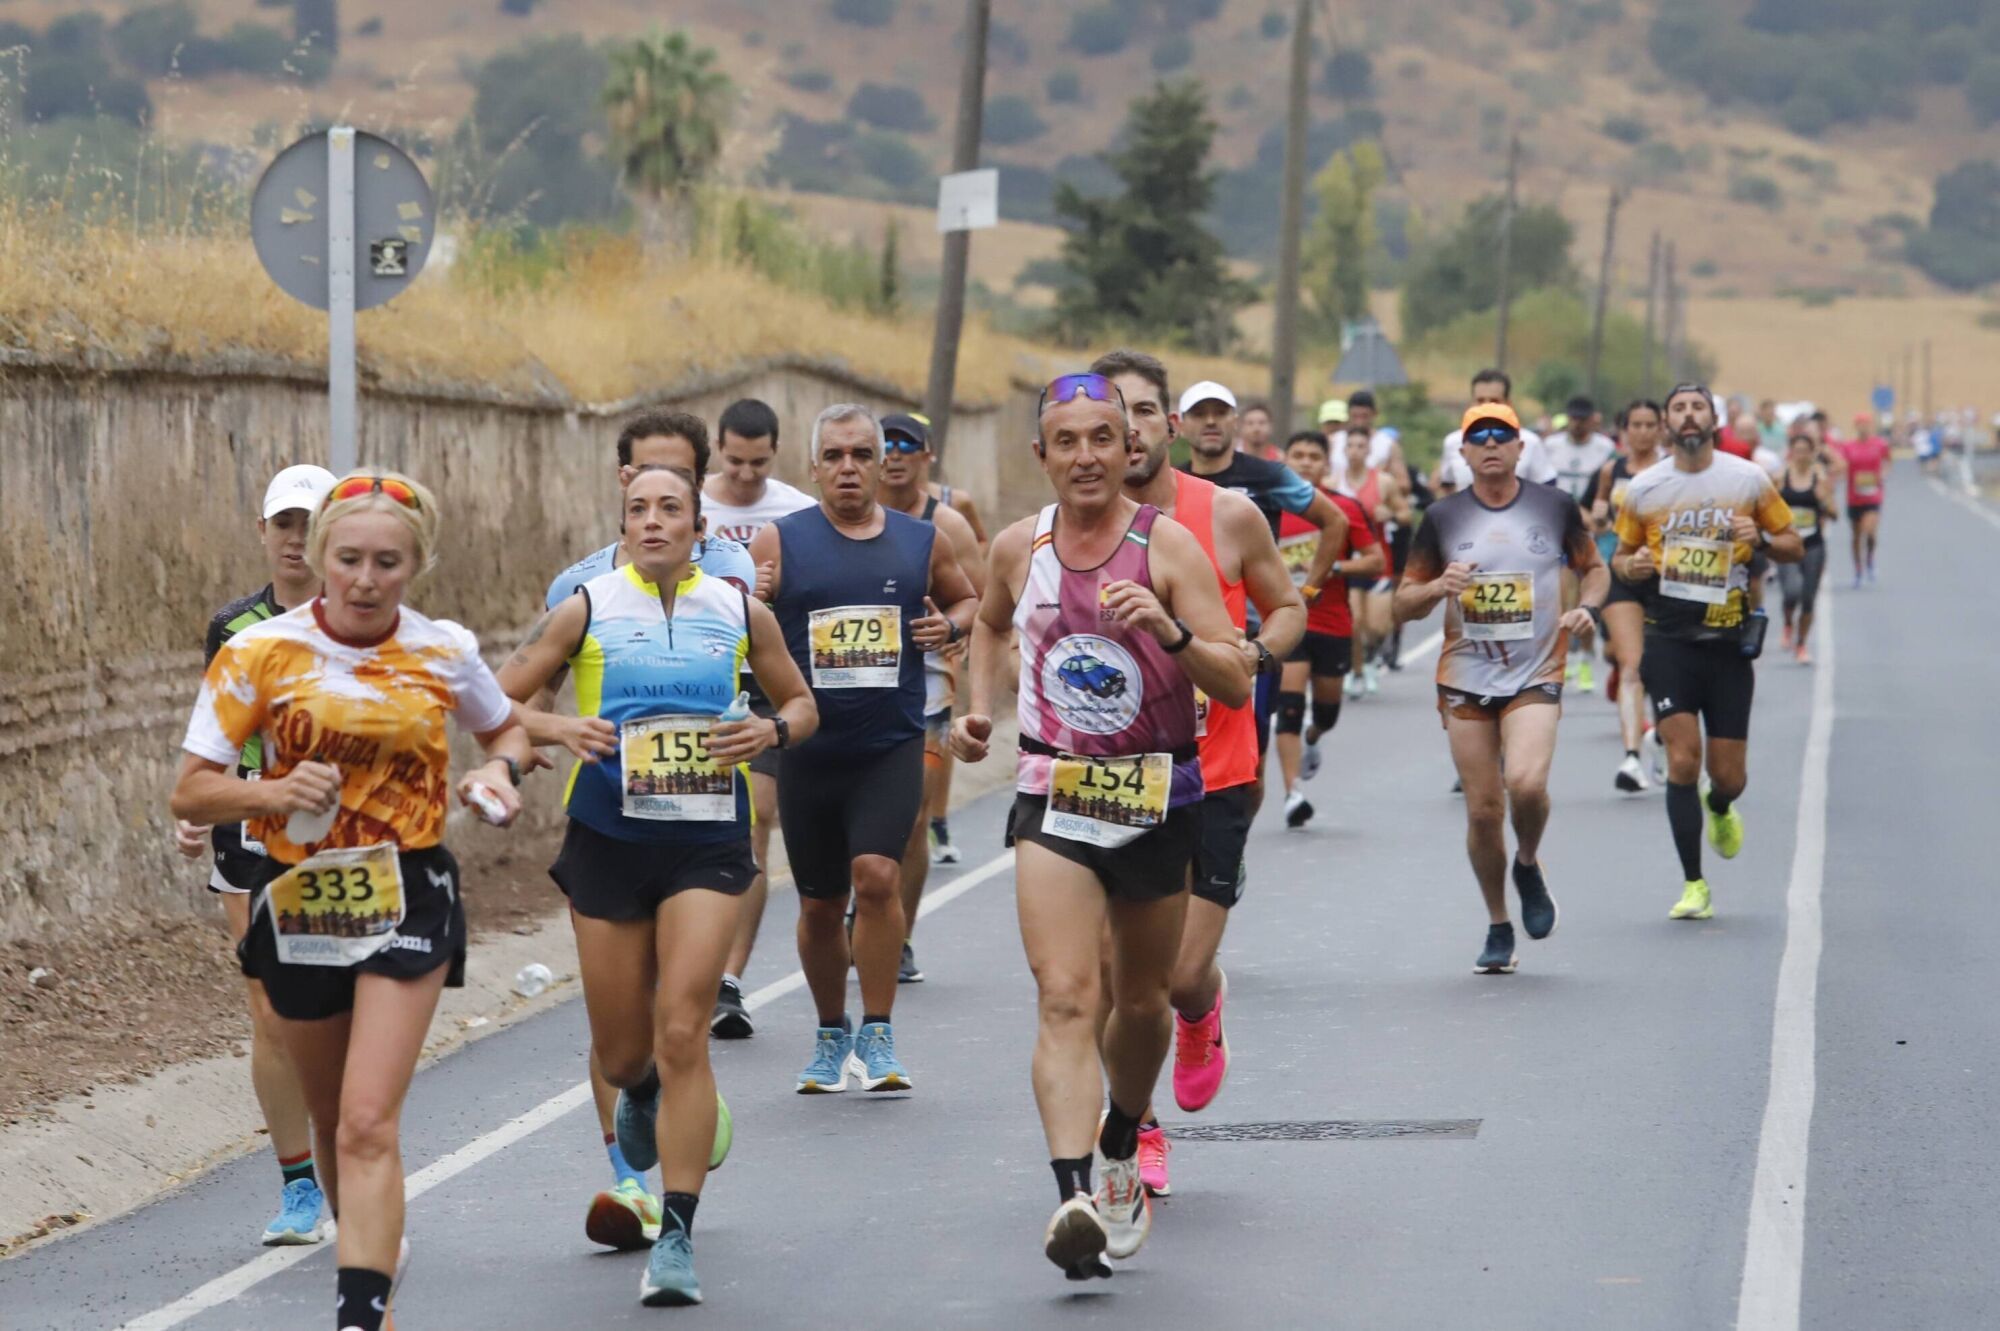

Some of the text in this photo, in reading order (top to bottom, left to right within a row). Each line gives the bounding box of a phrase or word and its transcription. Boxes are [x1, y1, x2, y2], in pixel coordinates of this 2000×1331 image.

[1660, 502, 1734, 533] JAÉN
[1679, 547, 1718, 568] 207
[1474, 583, 1518, 604] 422
[830, 618, 882, 643] 479
[651, 731, 711, 763] 155
[1079, 764, 1145, 796] 154
[297, 867, 374, 901] 333
